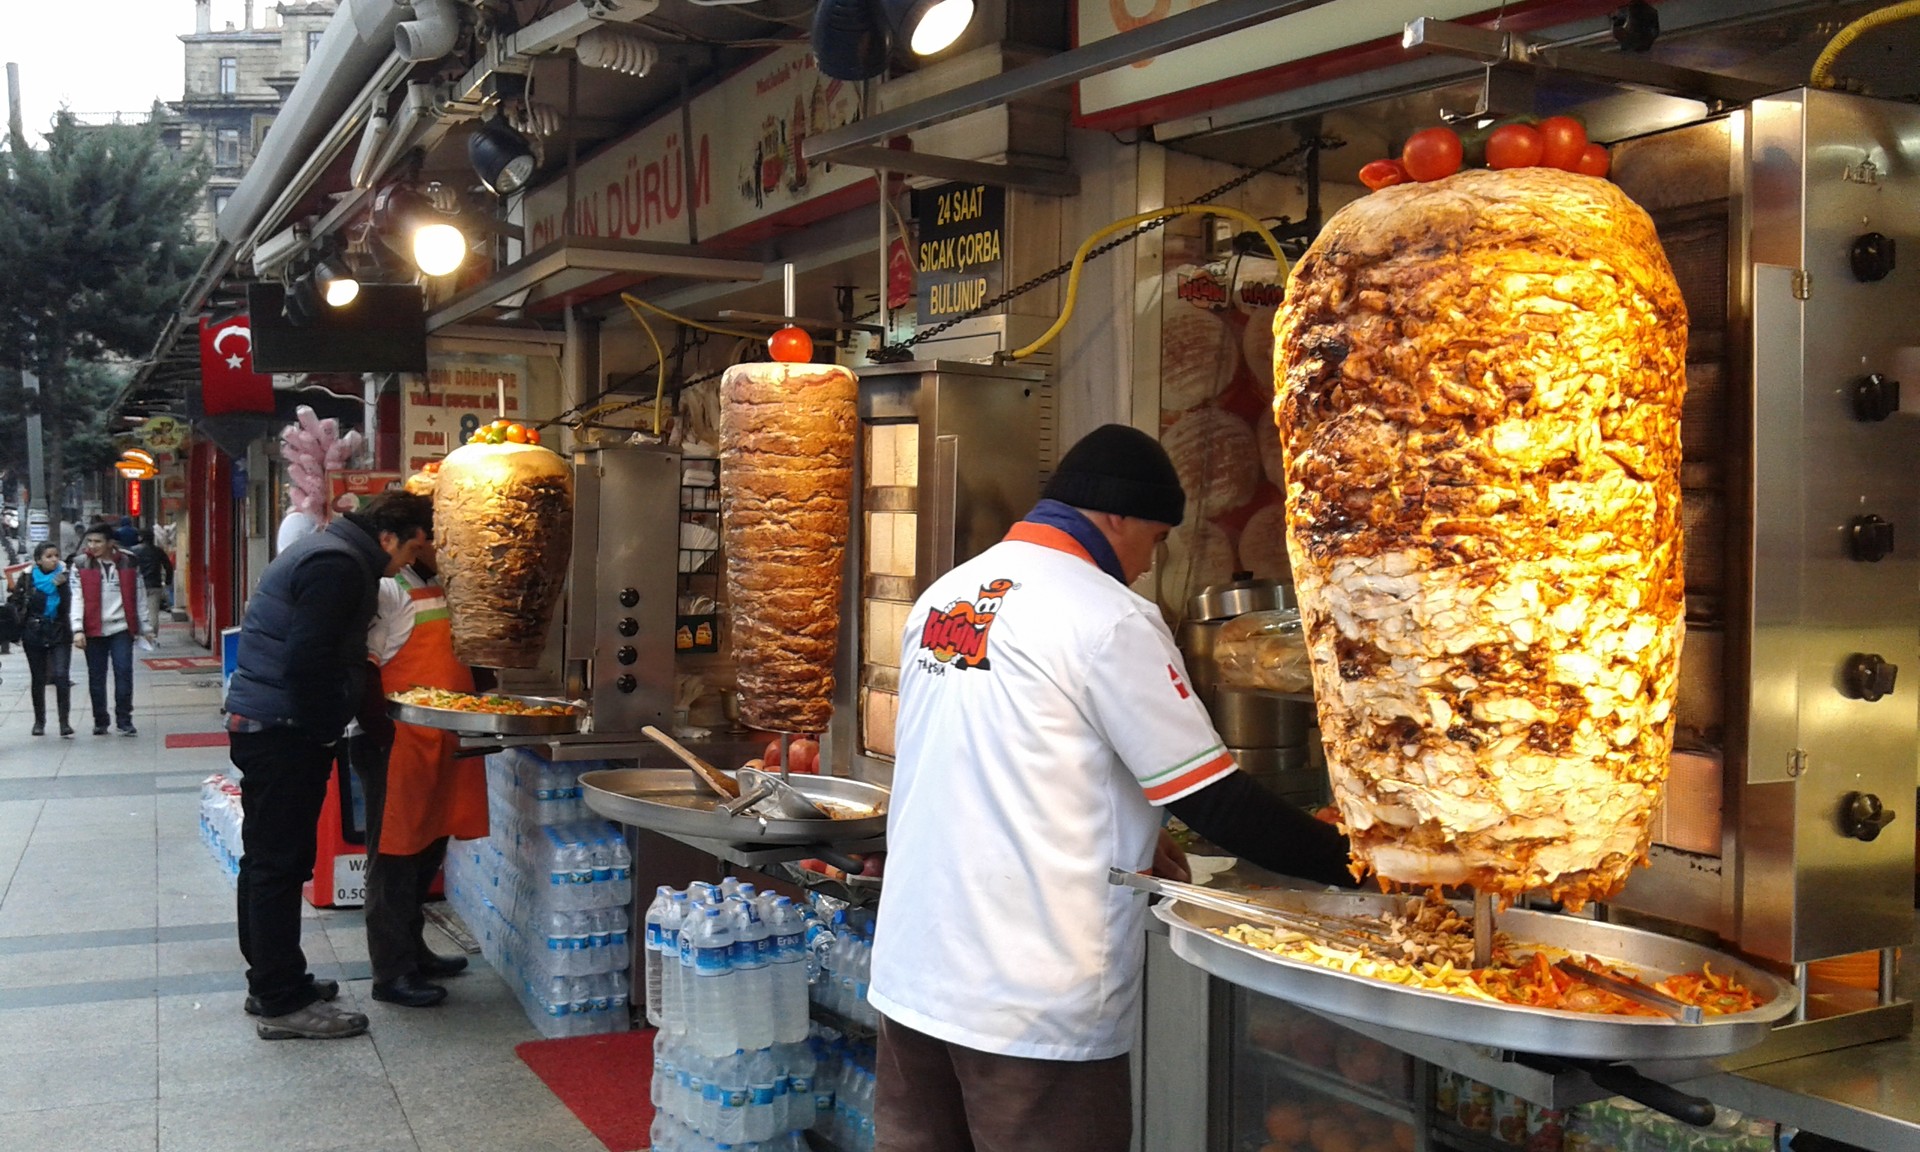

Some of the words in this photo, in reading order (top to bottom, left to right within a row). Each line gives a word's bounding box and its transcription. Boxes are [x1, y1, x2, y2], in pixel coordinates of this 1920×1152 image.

[938, 194, 951, 225] 24
[953, 185, 985, 222] SAAT
[920, 237, 956, 273] SICAK
[957, 229, 1001, 274] ÇORBA
[930, 278, 987, 315] BULUNUP
[459, 413, 480, 445] 8
[349, 859, 368, 872] WA
